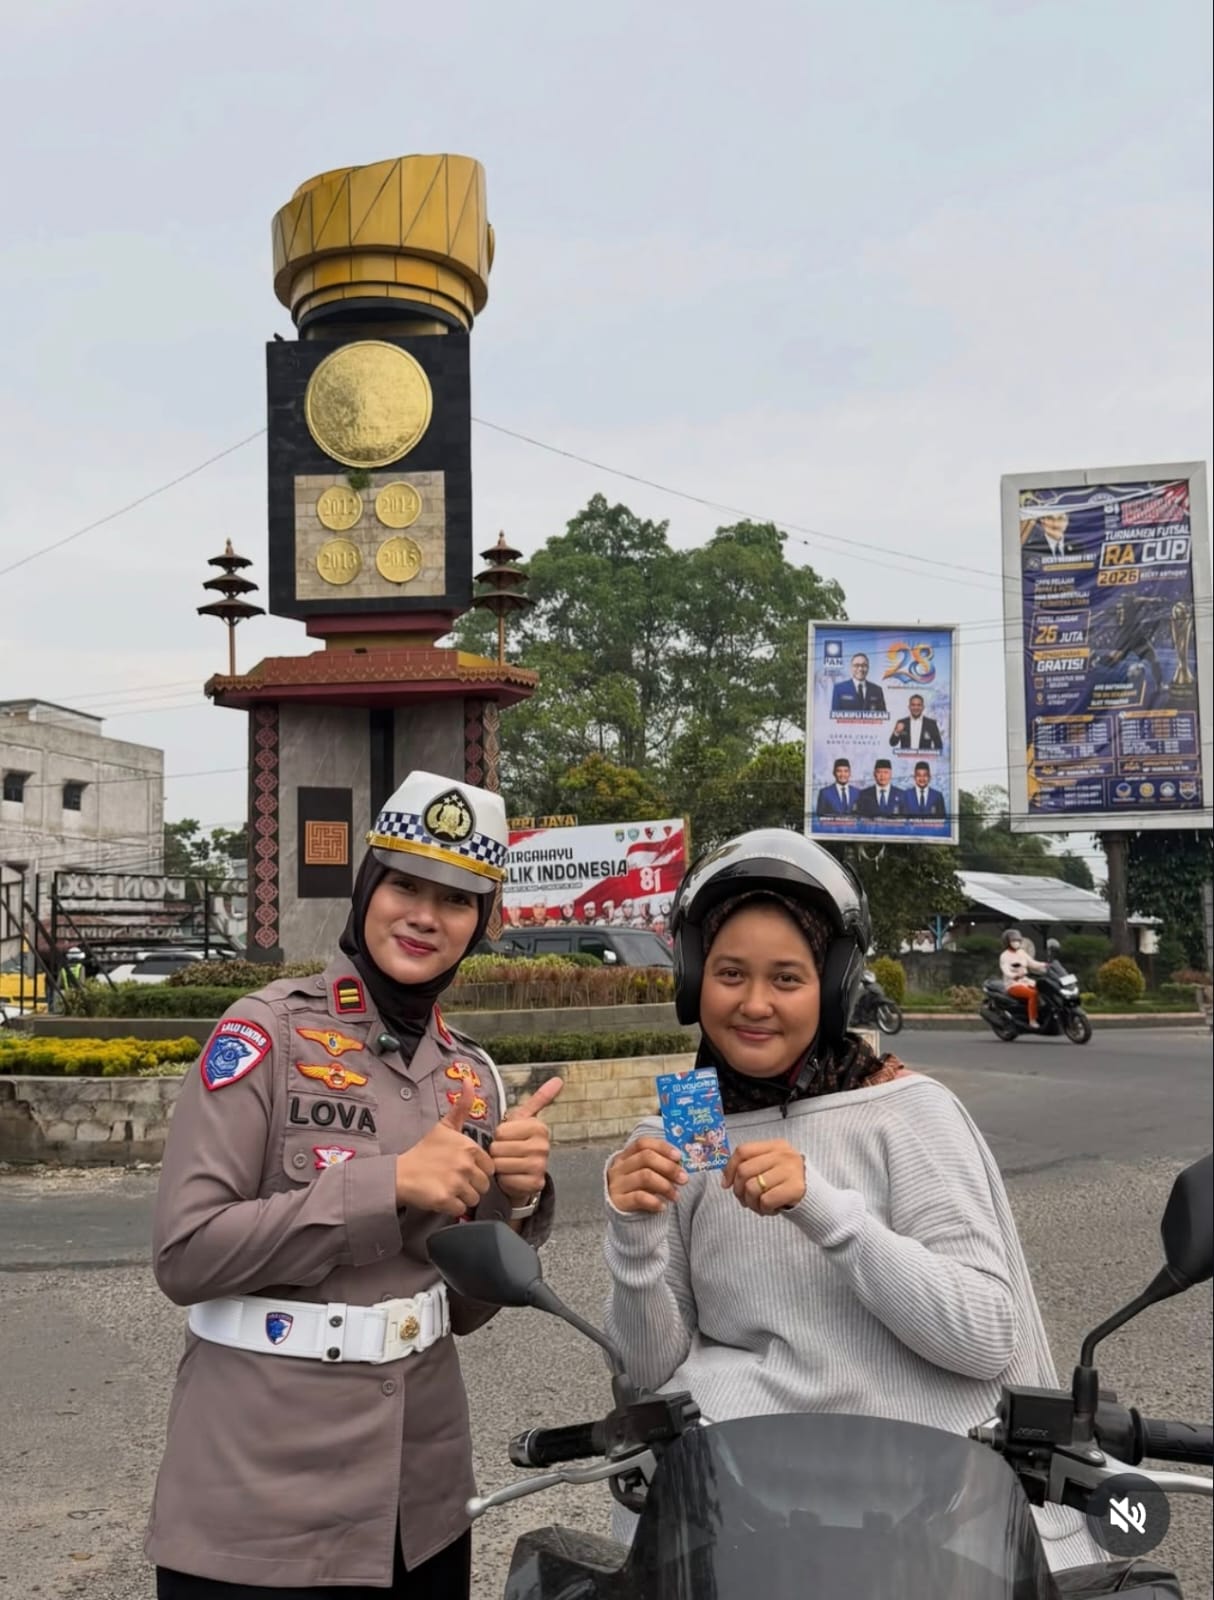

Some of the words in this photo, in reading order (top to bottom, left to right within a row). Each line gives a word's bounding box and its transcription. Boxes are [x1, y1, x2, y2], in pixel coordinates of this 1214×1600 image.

[322, 497, 358, 517] 2012
[383, 496, 416, 513] 2014
[1105, 528, 1155, 541] TURNAMEN
[1157, 525, 1190, 537] FUTSAL
[322, 551, 358, 570] 2013
[383, 549, 418, 568] 2015
[1104, 544, 1136, 565] RA
[1141, 539, 1187, 563] CUP
[1099, 571, 1137, 585] 2026
[1059, 630, 1083, 643] JUTA
[883, 640, 936, 684] 28
[1037, 658, 1085, 673] GRATIS!
[540, 815, 576, 827] JAYA
[537, 859, 628, 882] INDONESIA
[640, 867, 661, 892] 81
[221, 1022, 241, 1032] LALU
[240, 1025, 267, 1047] LINTAS
[290, 1096, 377, 1134] LOVA
